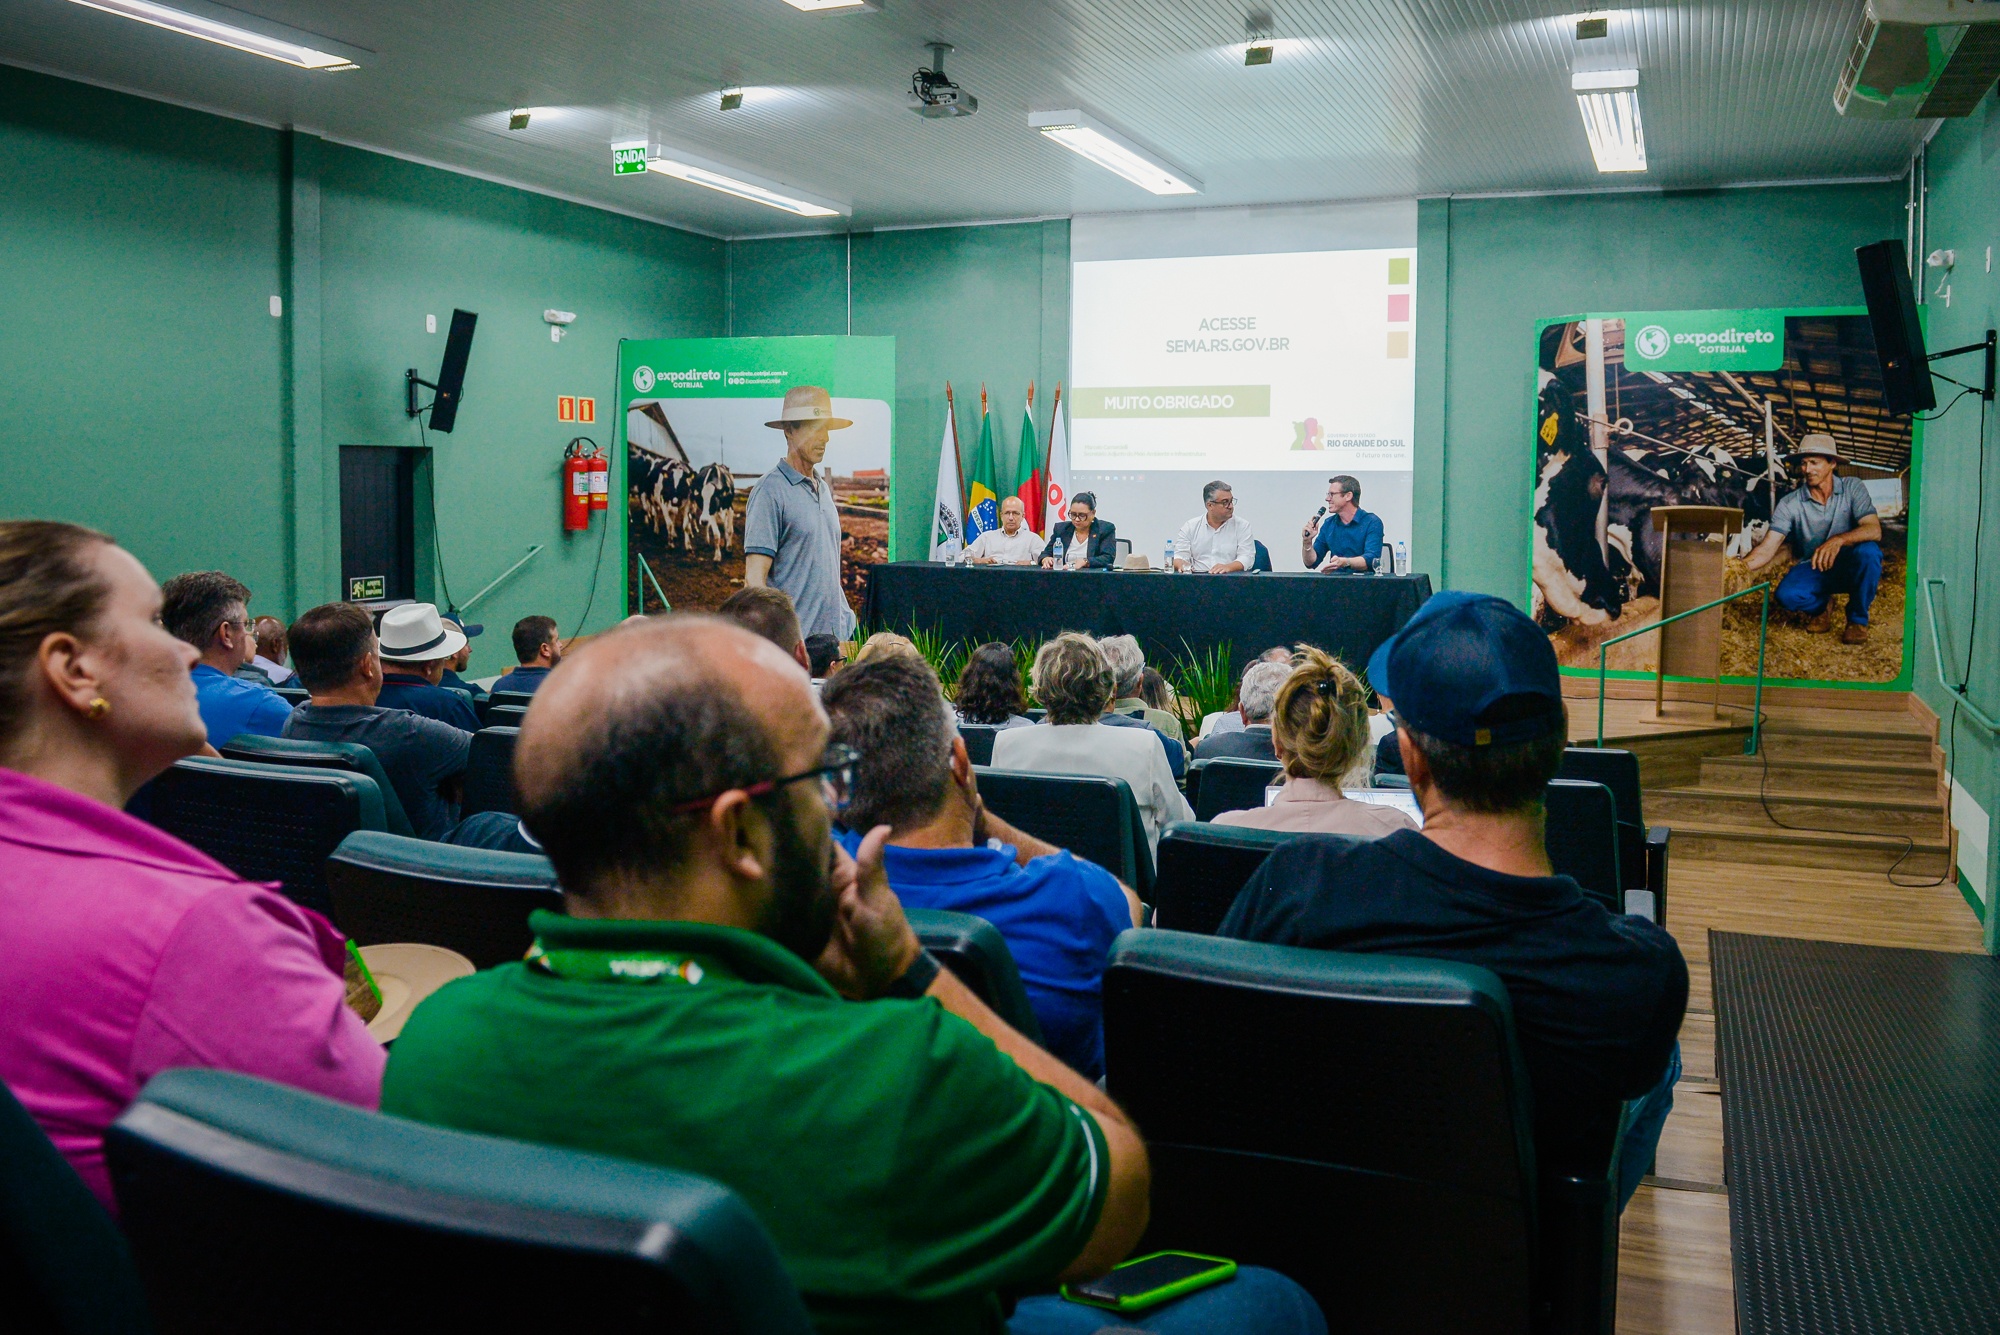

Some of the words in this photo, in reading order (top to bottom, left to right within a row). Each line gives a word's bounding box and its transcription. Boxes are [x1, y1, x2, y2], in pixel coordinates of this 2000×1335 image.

[1198, 317, 1257, 331] ACESSE
[1166, 337, 1290, 353] SEMA.RS.GOV.BR
[1673, 328, 1775, 347] expodireto
[1698, 345, 1747, 354] COTRIJAL
[657, 368, 721, 384] expodireto
[1104, 396, 1151, 410] MUITO
[1153, 394, 1234, 409] OBRIGADO
[1327, 439, 1341, 447] RIO
[1342, 439, 1375, 447] GRANDE
[1377, 439, 1389, 447] DO
[1390, 439, 1406, 447] SUL
